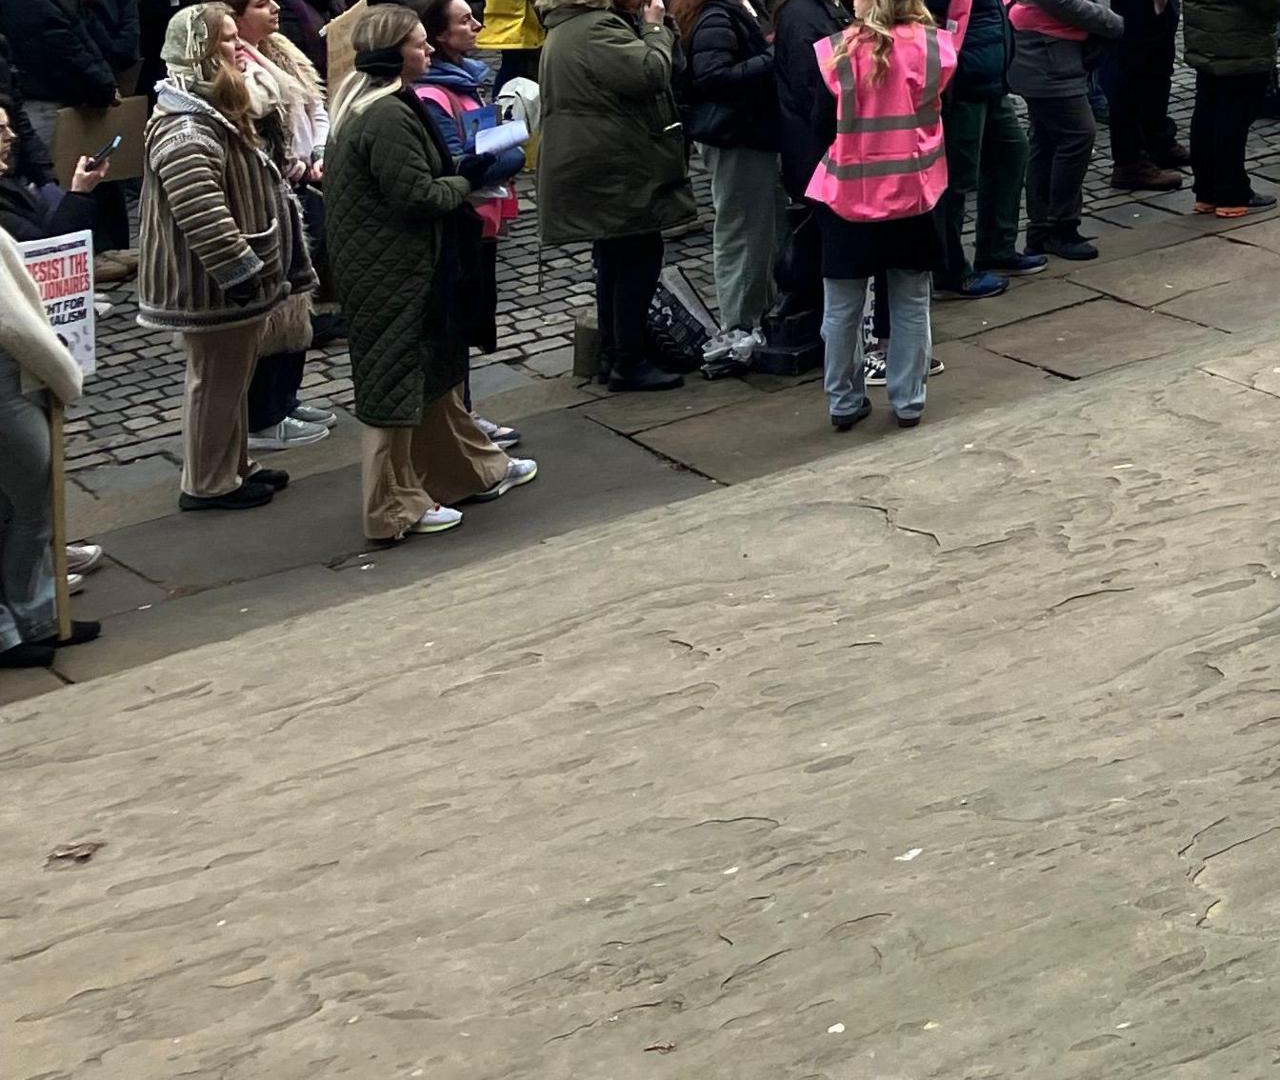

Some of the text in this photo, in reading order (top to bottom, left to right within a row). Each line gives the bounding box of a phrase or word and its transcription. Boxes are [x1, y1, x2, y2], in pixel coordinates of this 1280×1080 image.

[68, 252, 88, 275] THE
[39, 273, 90, 302] LIONAIRES
[64, 296, 85, 312] FOR
[50, 308, 87, 327] ALISM
